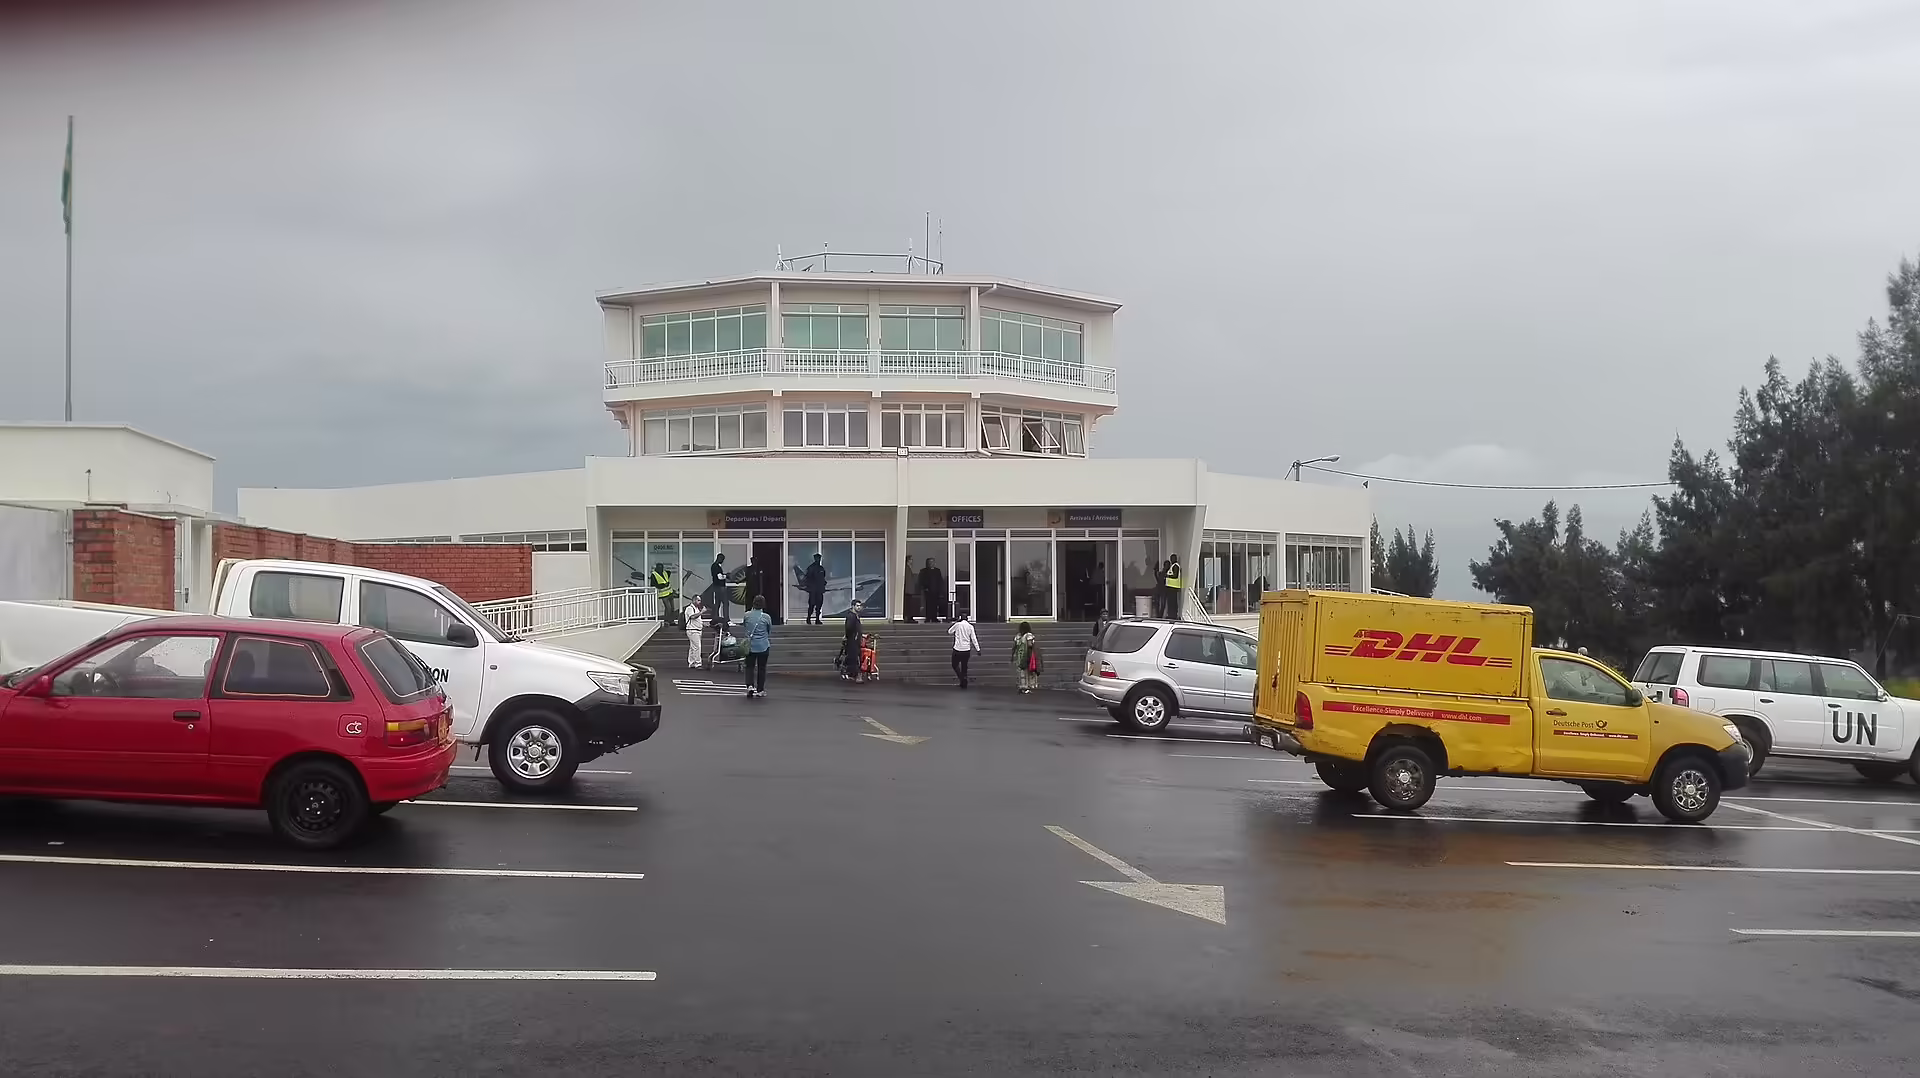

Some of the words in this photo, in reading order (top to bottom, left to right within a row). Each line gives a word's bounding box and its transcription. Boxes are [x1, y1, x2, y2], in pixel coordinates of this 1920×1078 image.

[951, 515, 982, 523] OFFICES
[1350, 628, 1488, 667] DHL
[1385, 707, 1405, 716] Simply
[1406, 709, 1434, 718] Delivered
[1441, 712, 1482, 722] www.dhl.com
[1553, 719, 1581, 728] Deutsche
[1581, 721, 1594, 729] Post
[1832, 710, 1878, 746] UN
